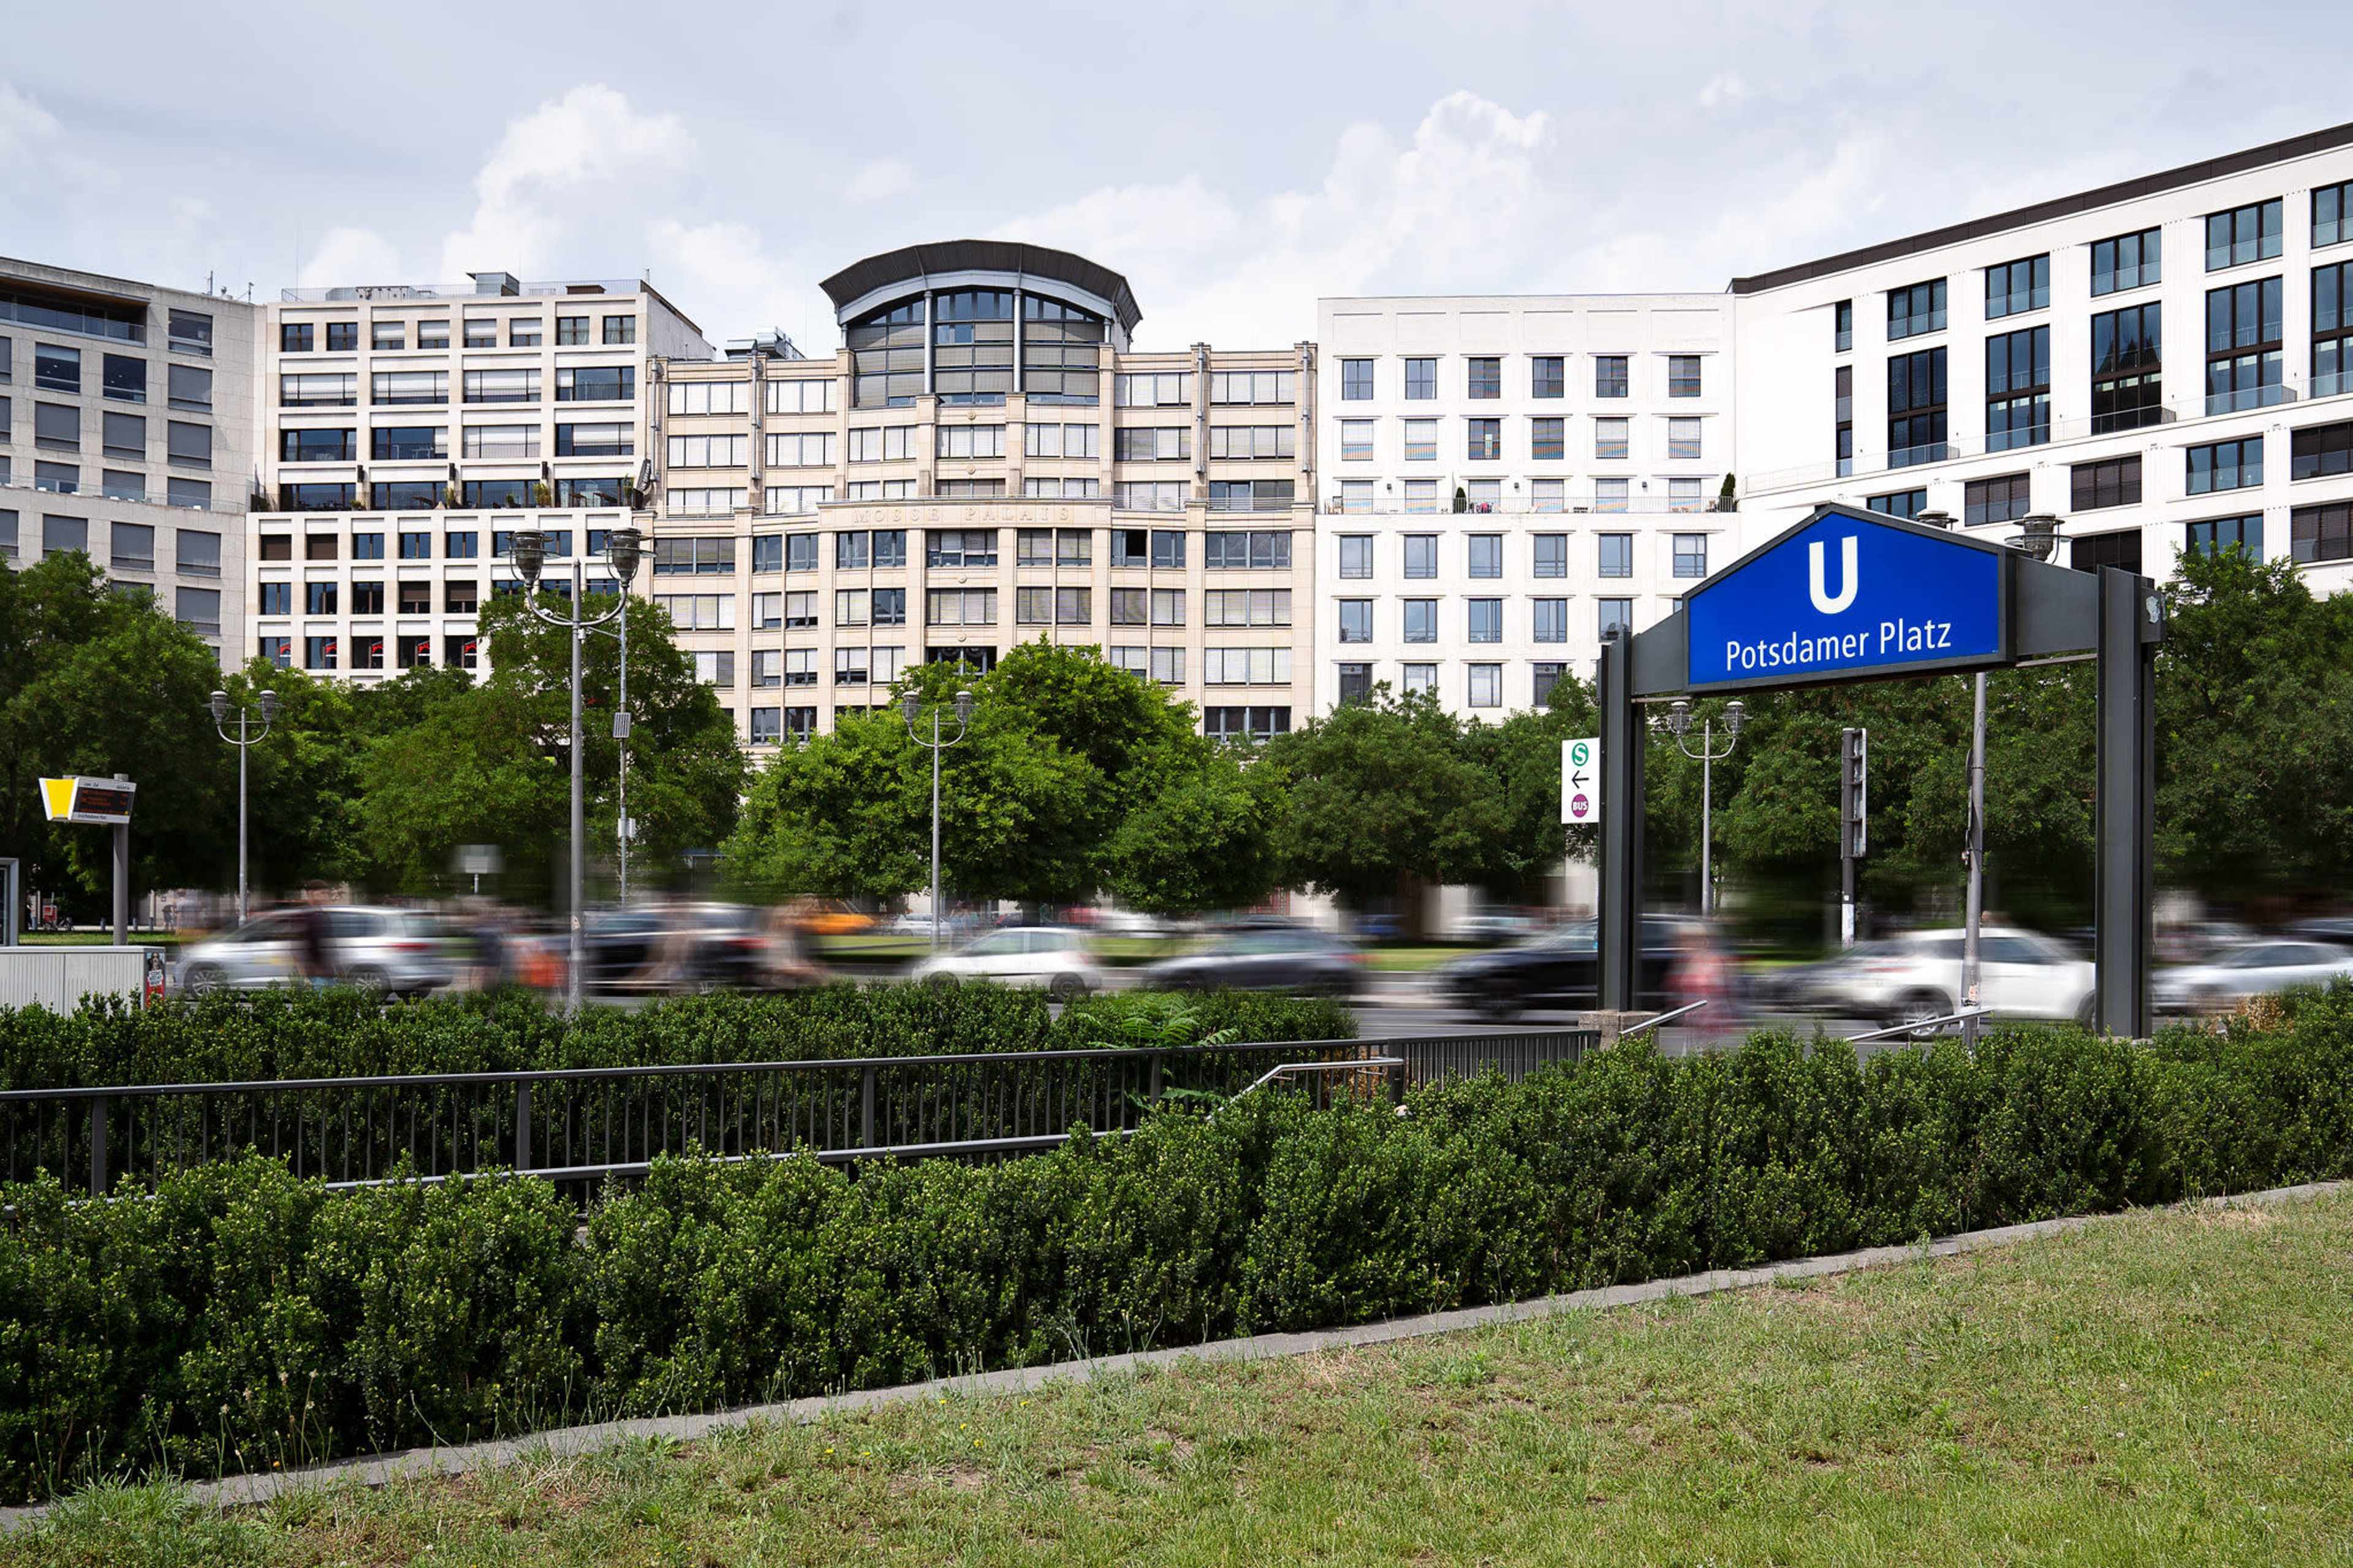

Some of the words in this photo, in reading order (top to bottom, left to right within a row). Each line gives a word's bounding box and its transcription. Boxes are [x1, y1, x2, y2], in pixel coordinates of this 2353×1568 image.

[854, 509, 941, 523] MOSSE
[964, 507, 1069, 521] PALAIS
[1809, 536, 1859, 614] U
[1727, 631, 1870, 671] Potsdamer
[1880, 618, 1951, 654] Platz
[1573, 744, 1588, 765] S
[1572, 801, 1588, 811] BUS
